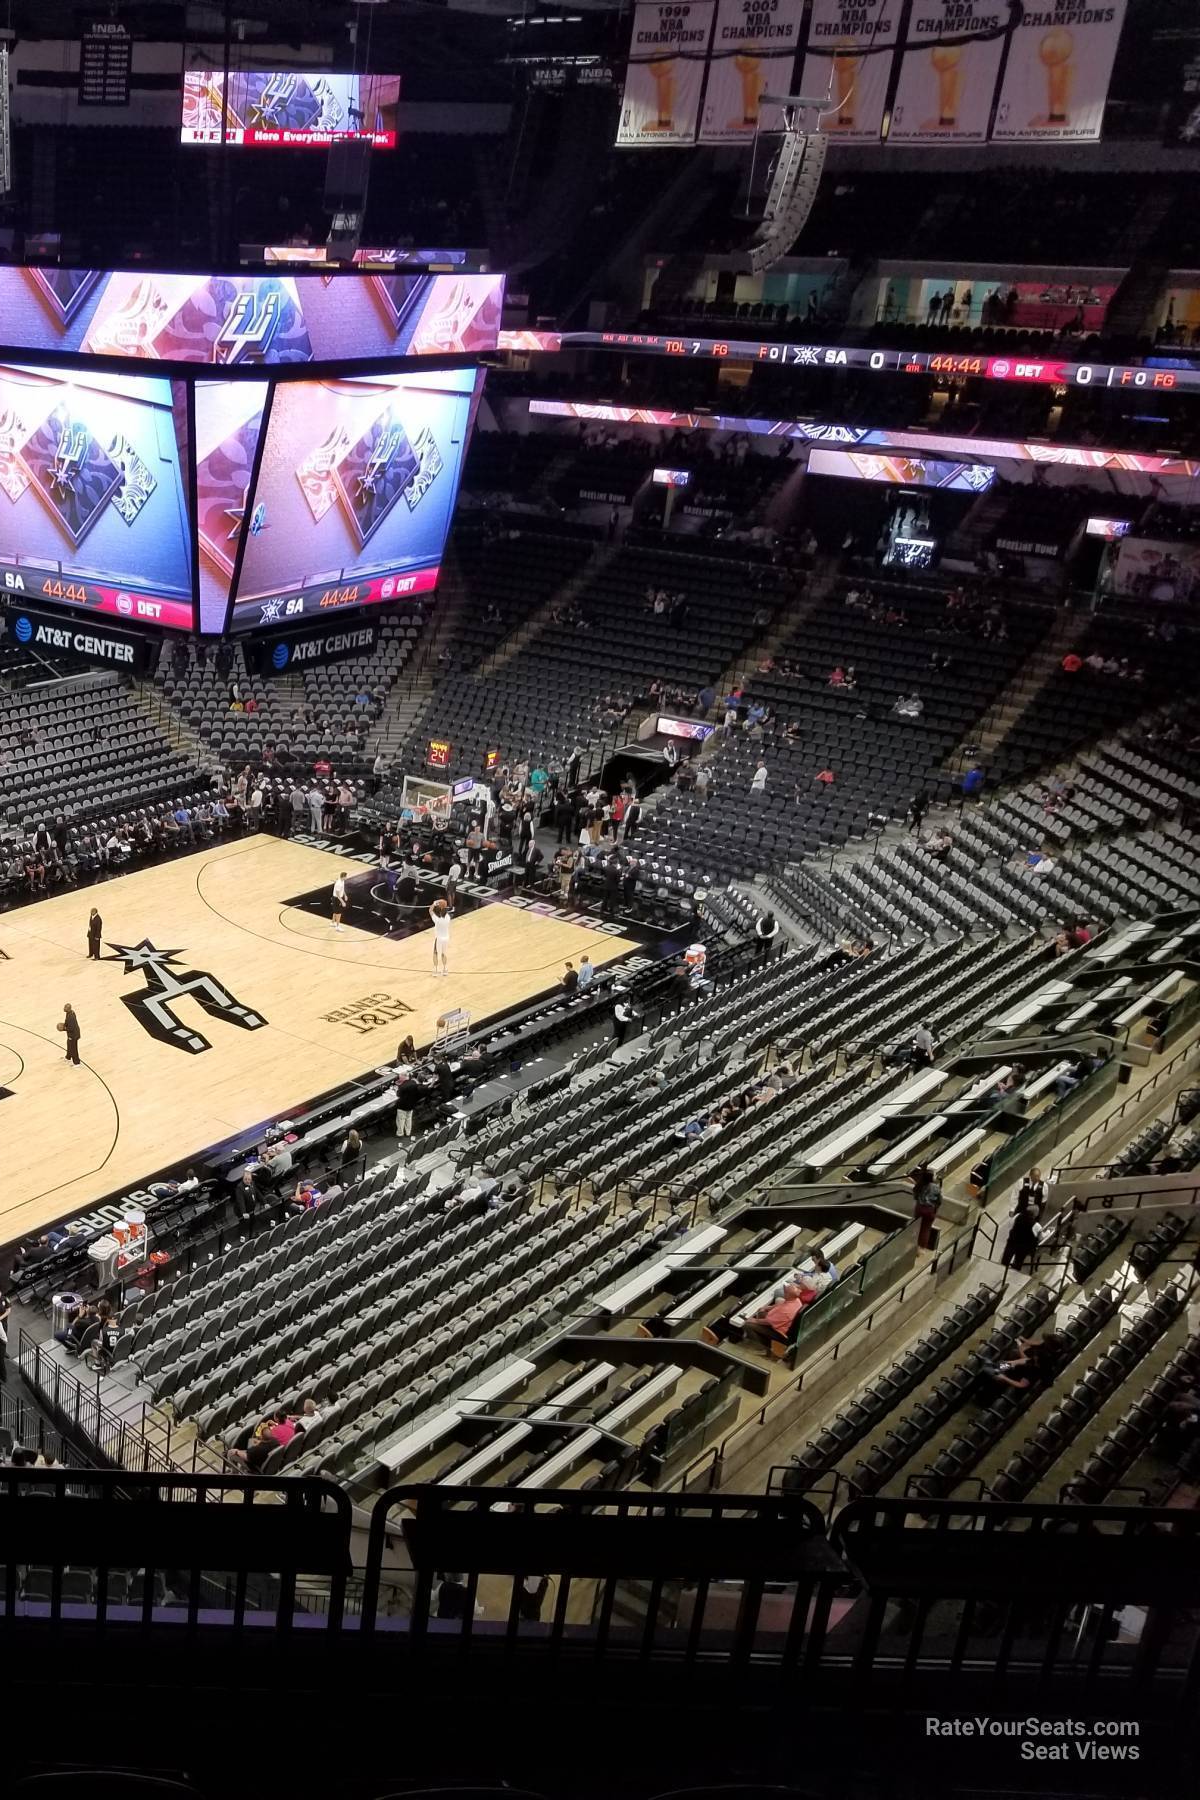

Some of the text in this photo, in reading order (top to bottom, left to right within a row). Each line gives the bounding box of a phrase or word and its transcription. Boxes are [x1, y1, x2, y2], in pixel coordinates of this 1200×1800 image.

[658, 6, 691, 18] 1999
[841, 9, 867, 22] NBA
[944, 3, 973, 18] NBA
[1022, 8, 1115, 27] CHAMPIONS
[97, 24, 126, 33] NBA
[660, 19, 684, 31] NBA
[746, 14, 771, 27] NBA
[815, 20, 892, 36] CHAMPIONS
[916, 16, 1000, 33] CHAMPIONS
[636, 29, 705, 44] CHAMPIONS
[721, 25, 793, 40] CHAMPIONS
[665, 341, 686, 353] TOL
[691, 343, 700, 354] 7
[712, 344, 728, 355] FG
[769, 347, 779, 359] 0
[824, 349, 848, 364] SA
[869, 352, 885, 369] 0
[911, 353, 918, 364] 1
[930, 356, 982, 374] 44:44
[1014, 363, 1045, 378] DET
[1075, 366, 1093, 384] 0
[1120, 371, 1133, 385] F
[1134, 371, 1147, 386] 0
[1154, 373, 1176, 387] FG
[5, 573, 162, 618] SA 44:44 DET
[285, 577, 417, 615] SA 44:44 DET
[35, 625, 134, 663] AT&T CENTER
[291, 628, 373, 662] AT&T CENTER
[431, 749, 445, 762] 24
[287, 833, 356, 855] SAN
[501, 895, 629, 936] SPURS
[318, 993, 391, 1023] CENTER
[341, 999, 418, 1034] AT&T
